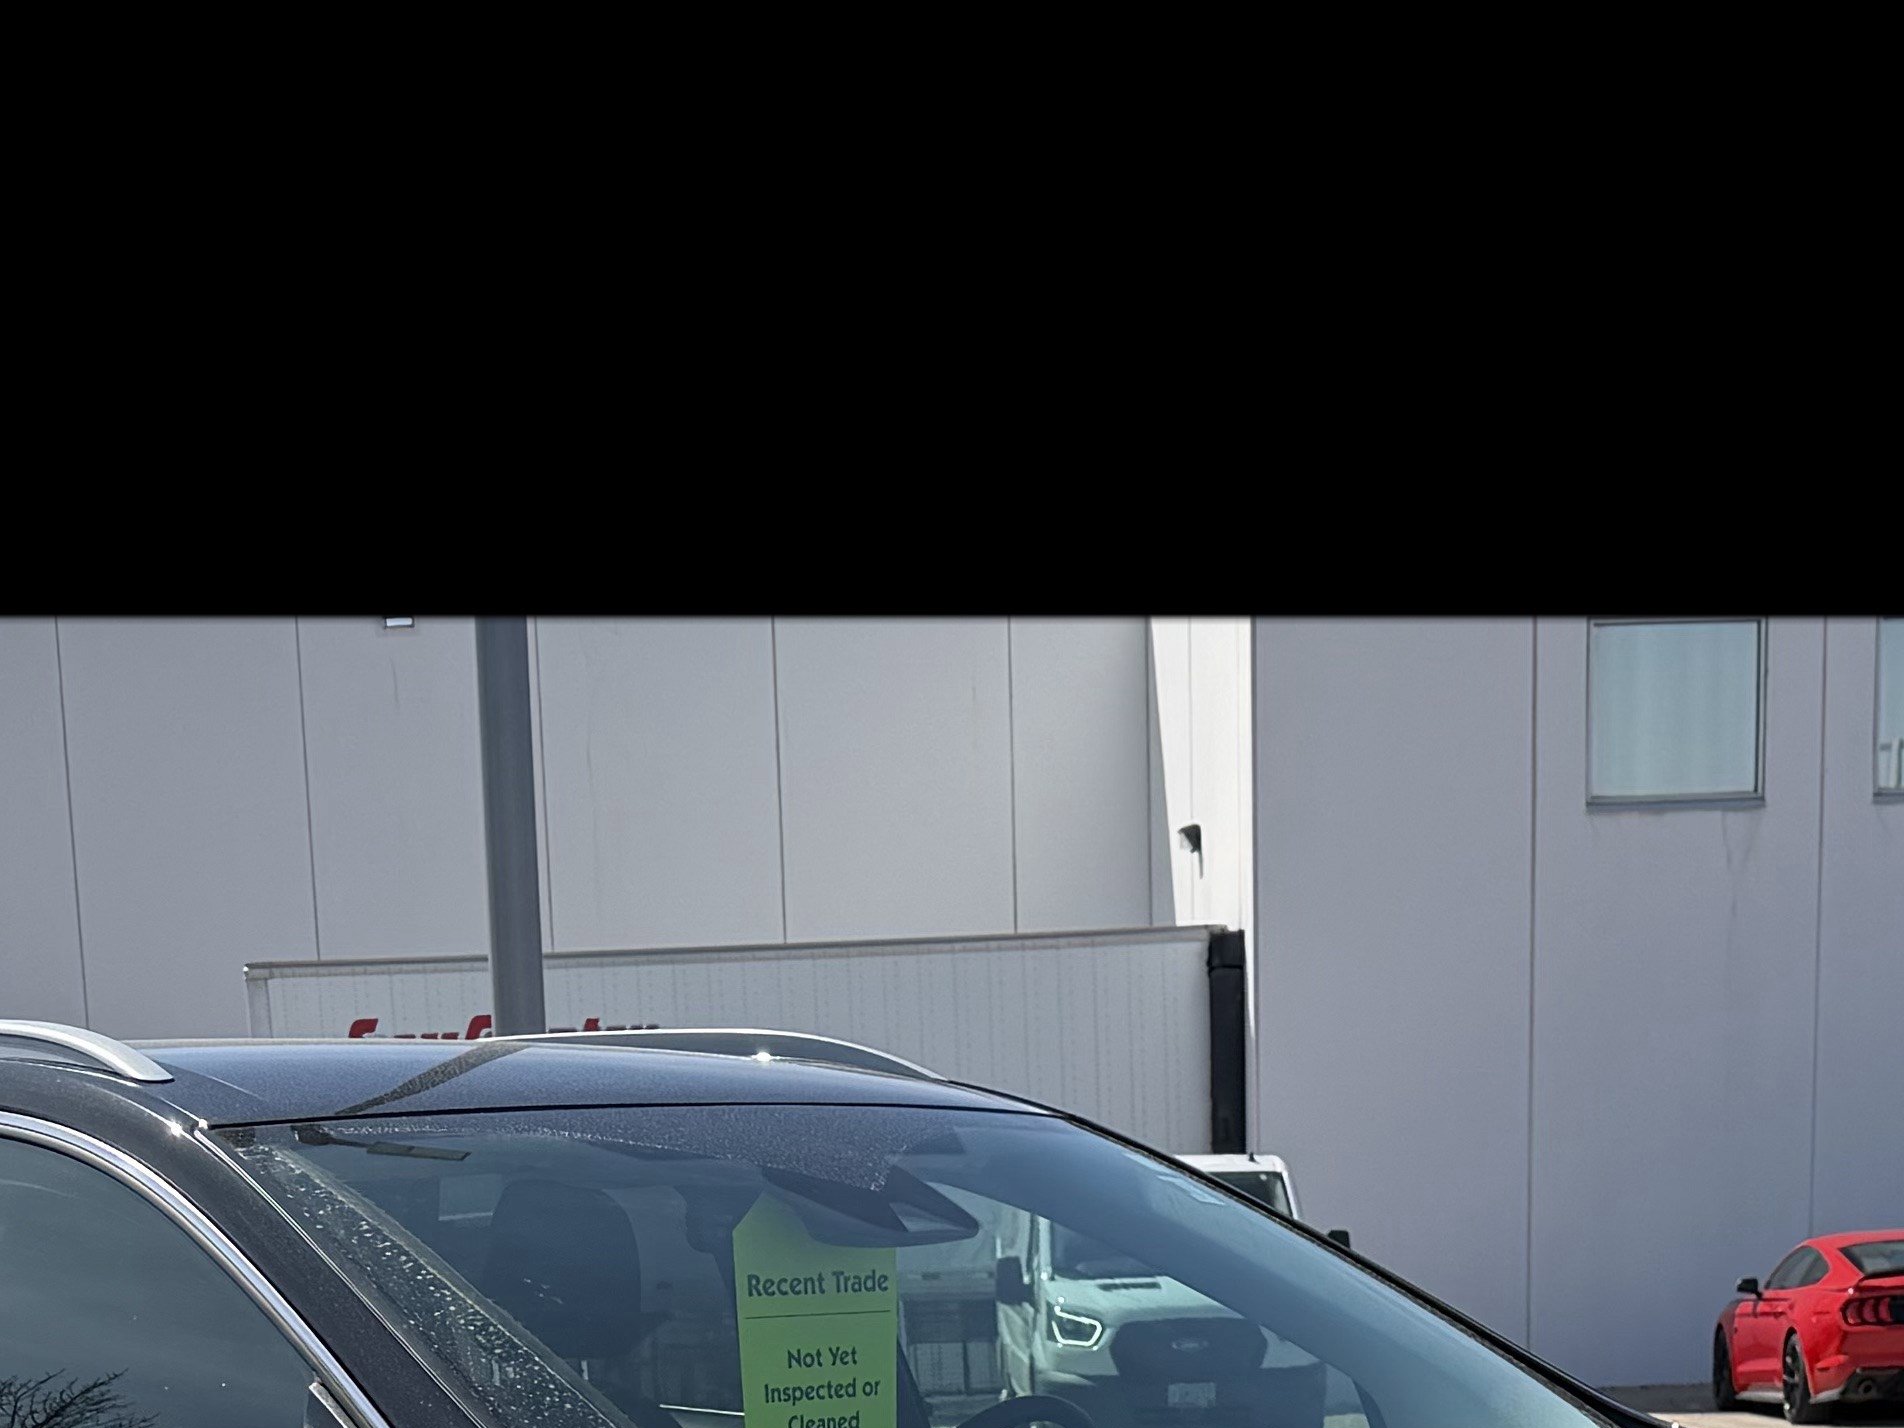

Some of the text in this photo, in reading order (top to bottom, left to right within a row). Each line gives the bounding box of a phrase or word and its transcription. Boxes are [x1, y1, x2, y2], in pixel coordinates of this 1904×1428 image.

[747, 1268, 889, 1297] Recent Trade
[787, 1346, 858, 1369] Not Yet
[764, 1377, 881, 1406] Inspected or
